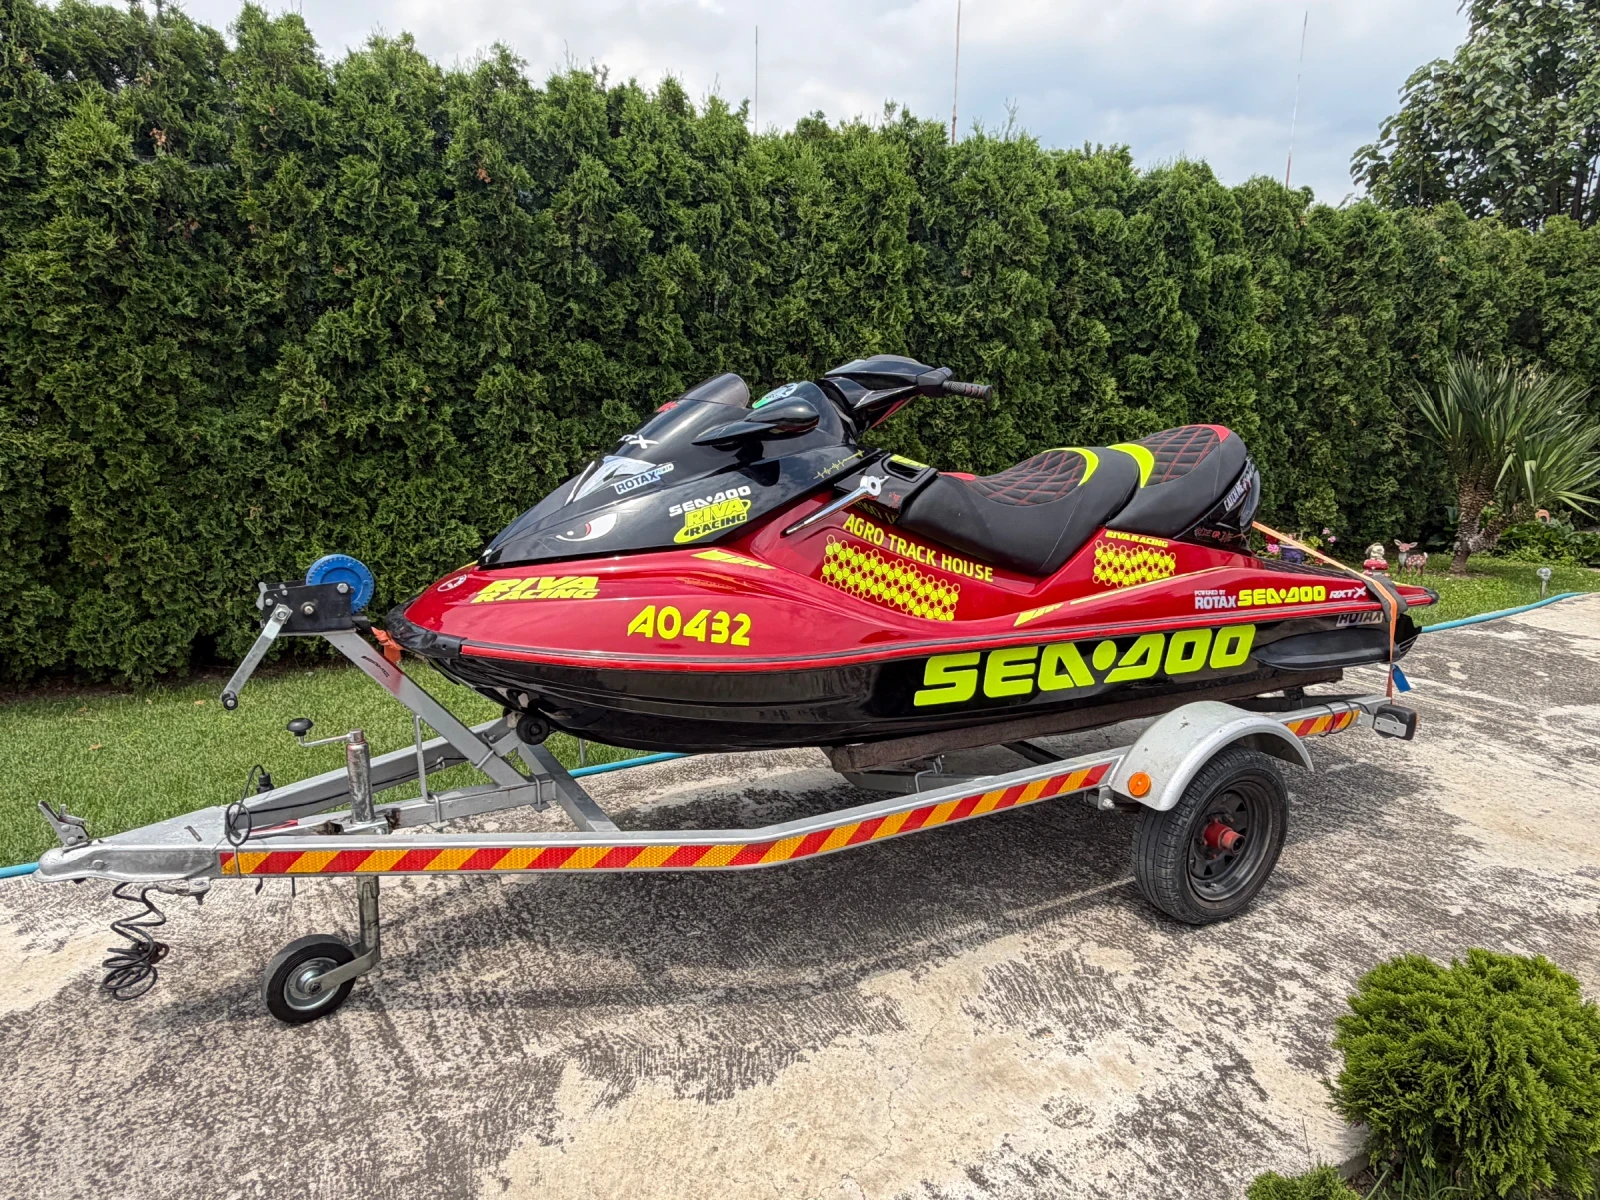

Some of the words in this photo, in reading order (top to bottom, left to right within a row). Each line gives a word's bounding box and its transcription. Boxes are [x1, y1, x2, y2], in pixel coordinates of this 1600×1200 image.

[616, 471, 658, 493] ROTAX
[686, 498, 744, 527] RIVA
[689, 512, 746, 536] RACING
[843, 513, 885, 546] AGRO
[888, 533, 937, 567] TRACK
[941, 553, 994, 583] HOUSE
[470, 588, 600, 603] RACING
[477, 576, 599, 594] RIVA
[1195, 596, 1236, 610] ROTAX
